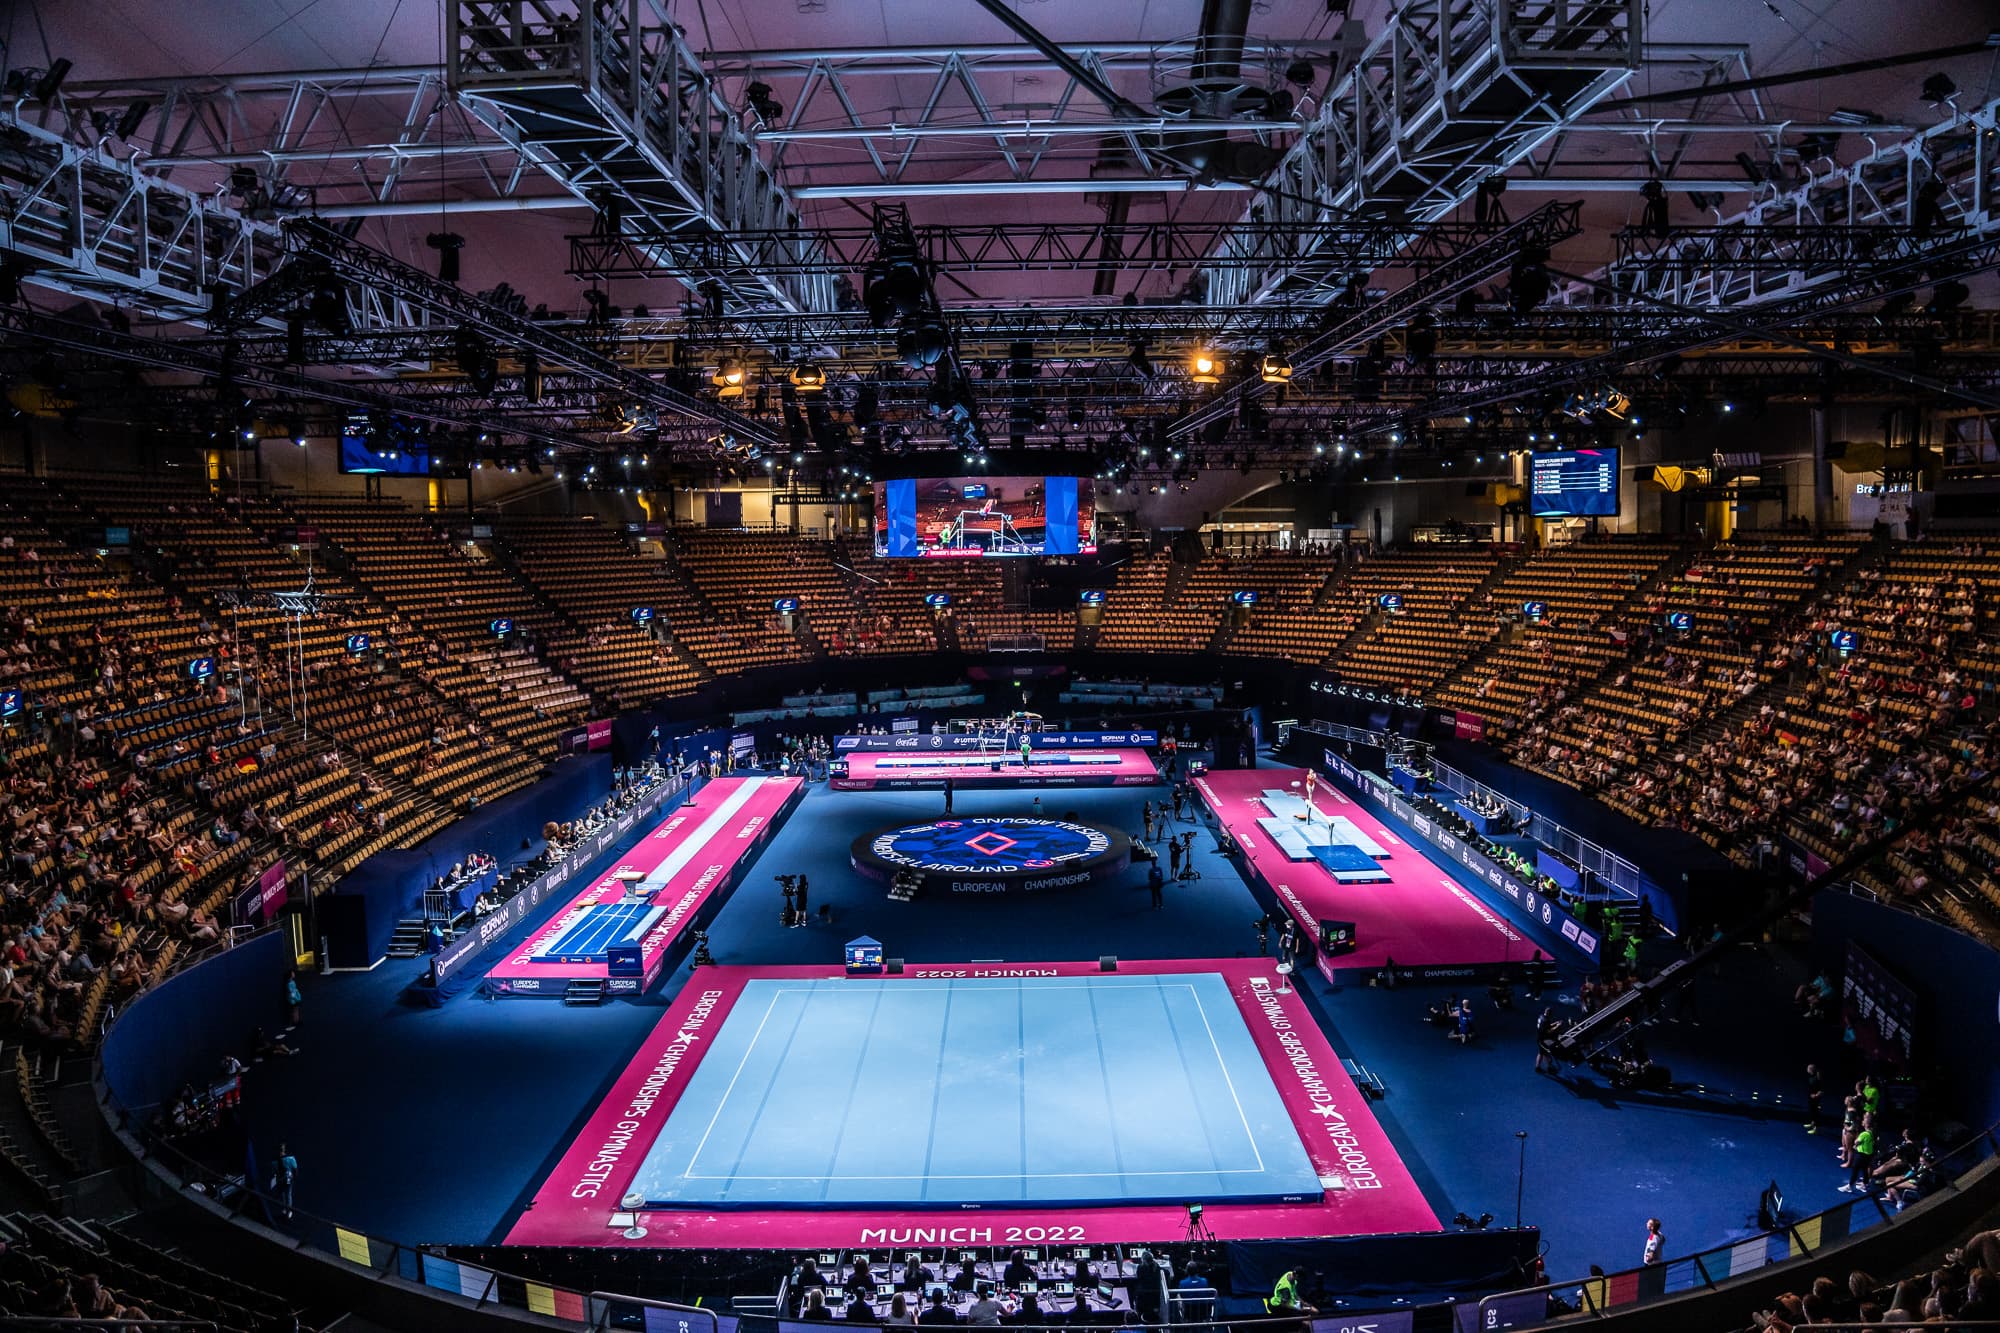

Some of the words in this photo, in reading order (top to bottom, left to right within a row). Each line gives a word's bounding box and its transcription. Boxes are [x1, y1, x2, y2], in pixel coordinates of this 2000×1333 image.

[921, 863, 1018, 874] AROUND
[953, 882, 1006, 893] EUROPEAN
[1024, 872, 1091, 890] CHAMPIONSHIPS
[480, 907, 509, 939] BORNAN
[916, 970, 966, 978] 2022
[1424, 969, 1475, 977] CHAMPIONSHIPS
[684, 990, 723, 1030] EUROPEAN
[624, 1045, 688, 1118] CHAMPIONSHIPS
[1277, 1031, 1333, 1103] CHAMPIONSHIPS
[571, 1121, 640, 1198] GYMNASTICS
[1324, 1122, 1383, 1190] EUROPEAN
[860, 1227, 992, 1243] MUNICH
[1005, 1226, 1086, 1241] 2022
